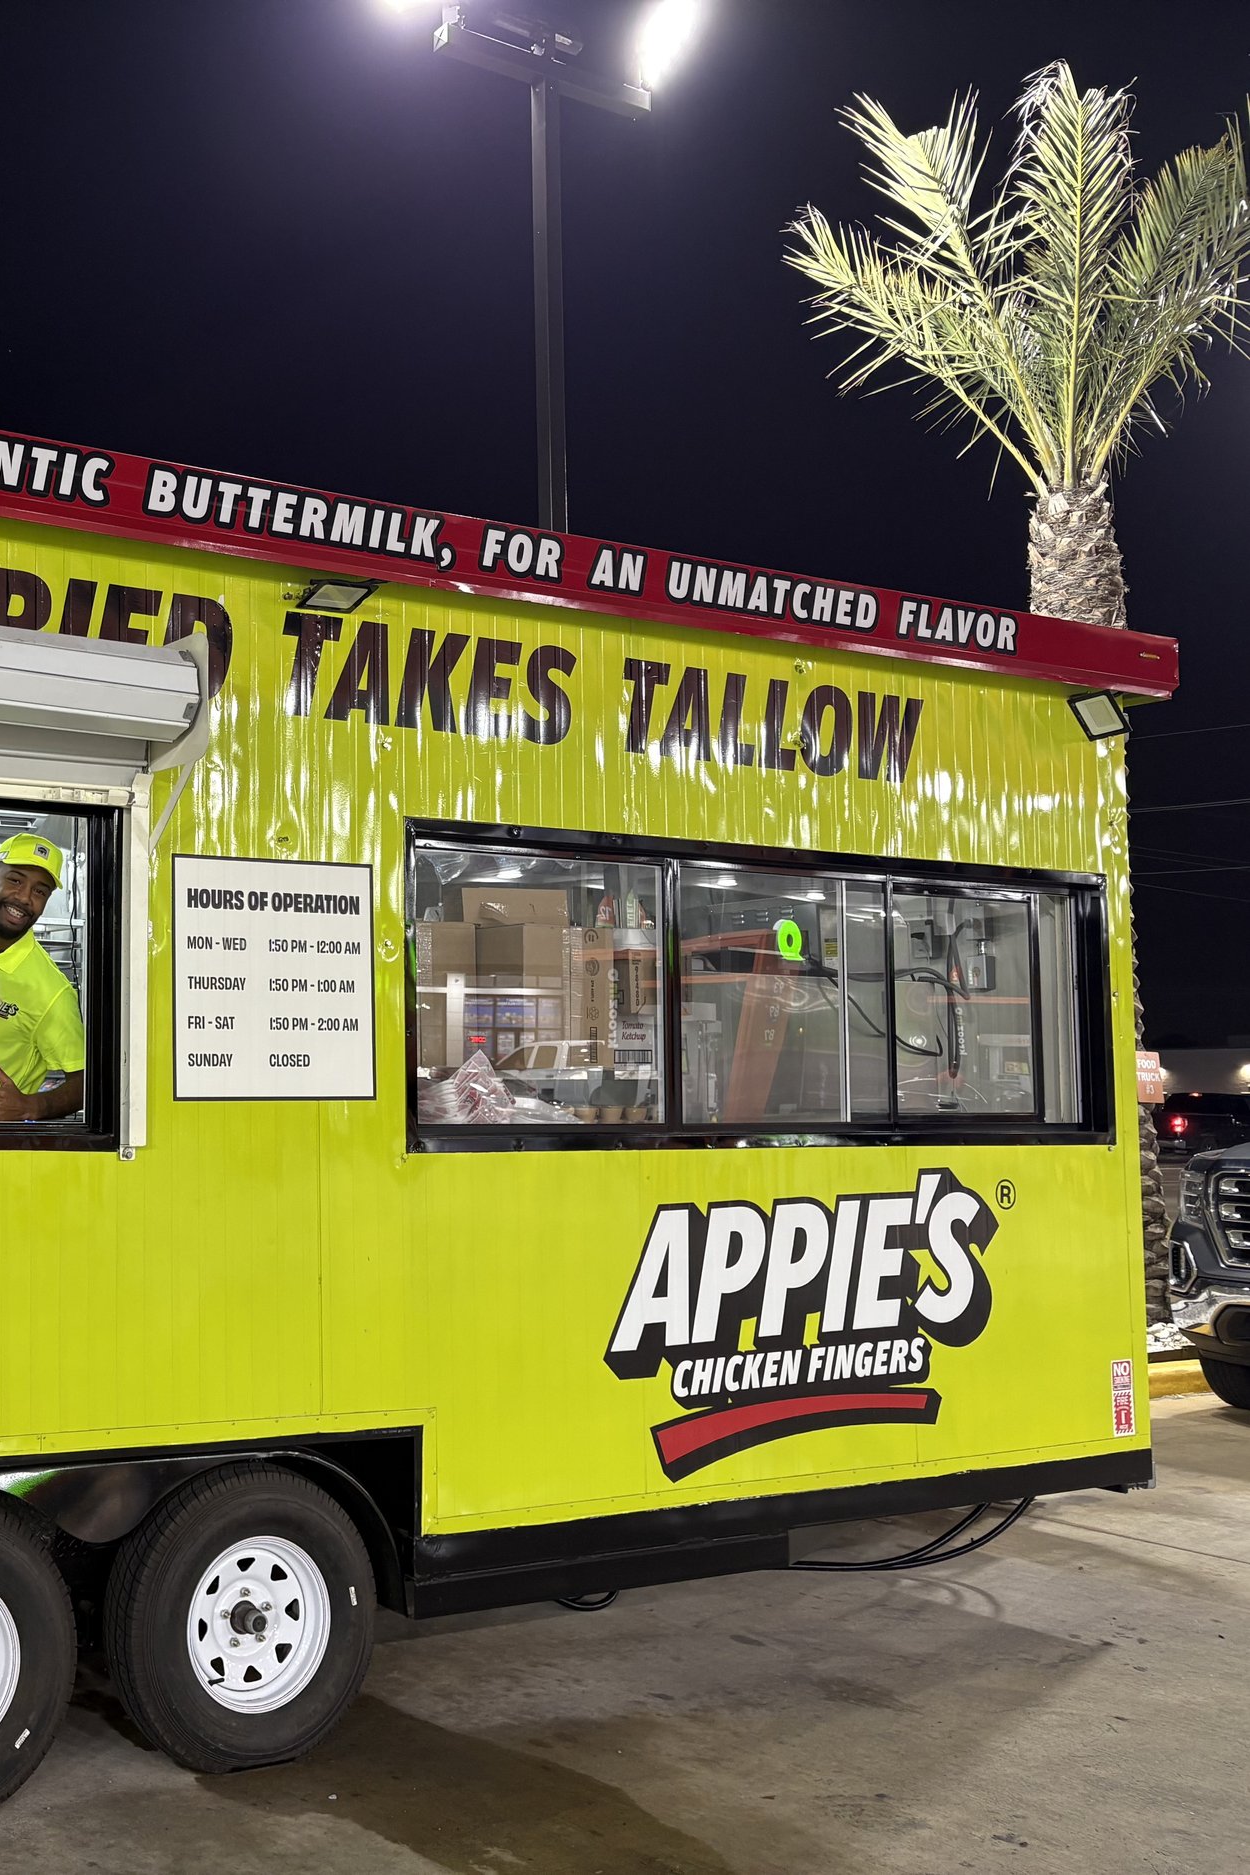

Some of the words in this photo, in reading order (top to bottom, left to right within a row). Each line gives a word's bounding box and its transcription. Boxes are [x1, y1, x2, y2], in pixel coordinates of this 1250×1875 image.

[147, 469, 453, 569] BUTTERMILK,
[481, 529, 561, 578] FOR
[591, 549, 644, 592] AN
[668, 562, 877, 630] UNMATCHED
[898, 601, 1016, 651] FLAVOR
[282, 611, 576, 745] TAKES
[622, 657, 923, 783] TALLOW
[187, 889, 244, 910] HOURS
[248, 891, 268, 911] OF
[272, 892, 359, 915] OPERATION
[187, 936, 212, 949] MON
[222, 937, 246, 950] WED
[269, 939, 288, 952] 1:50
[291, 940, 307, 953] PM
[317, 941, 341, 954] 12:00
[344, 942, 360, 954] AM
[188, 976, 246, 990] THURSDAY
[269, 978, 288, 992] 1:50
[292, 979, 307, 992] PM
[318, 980, 336, 992] 1:00
[339, 980, 354, 993] AM
[188, 1016, 205, 1029] FRI
[215, 1016, 235, 1029] SAT
[270, 1017, 289, 1030] 1:50
[292, 1018, 308, 1030] PM
[318, 1018, 339, 1031] 2:00
[342, 1018, 358, 1031] AM
[188, 1054, 233, 1067] SUNDAY
[269, 1054, 310, 1067] CLOSED
[1136, 1059, 1157, 1069] FOOD
[1136, 1071, 1161, 1082] TRUCK
[610, 1174, 981, 1352] APPIE'S
[673, 1348, 802, 1398] CHICKEN
[809, 1337, 924, 1383] FINGERS
[1113, 1362, 1130, 1377] NO
